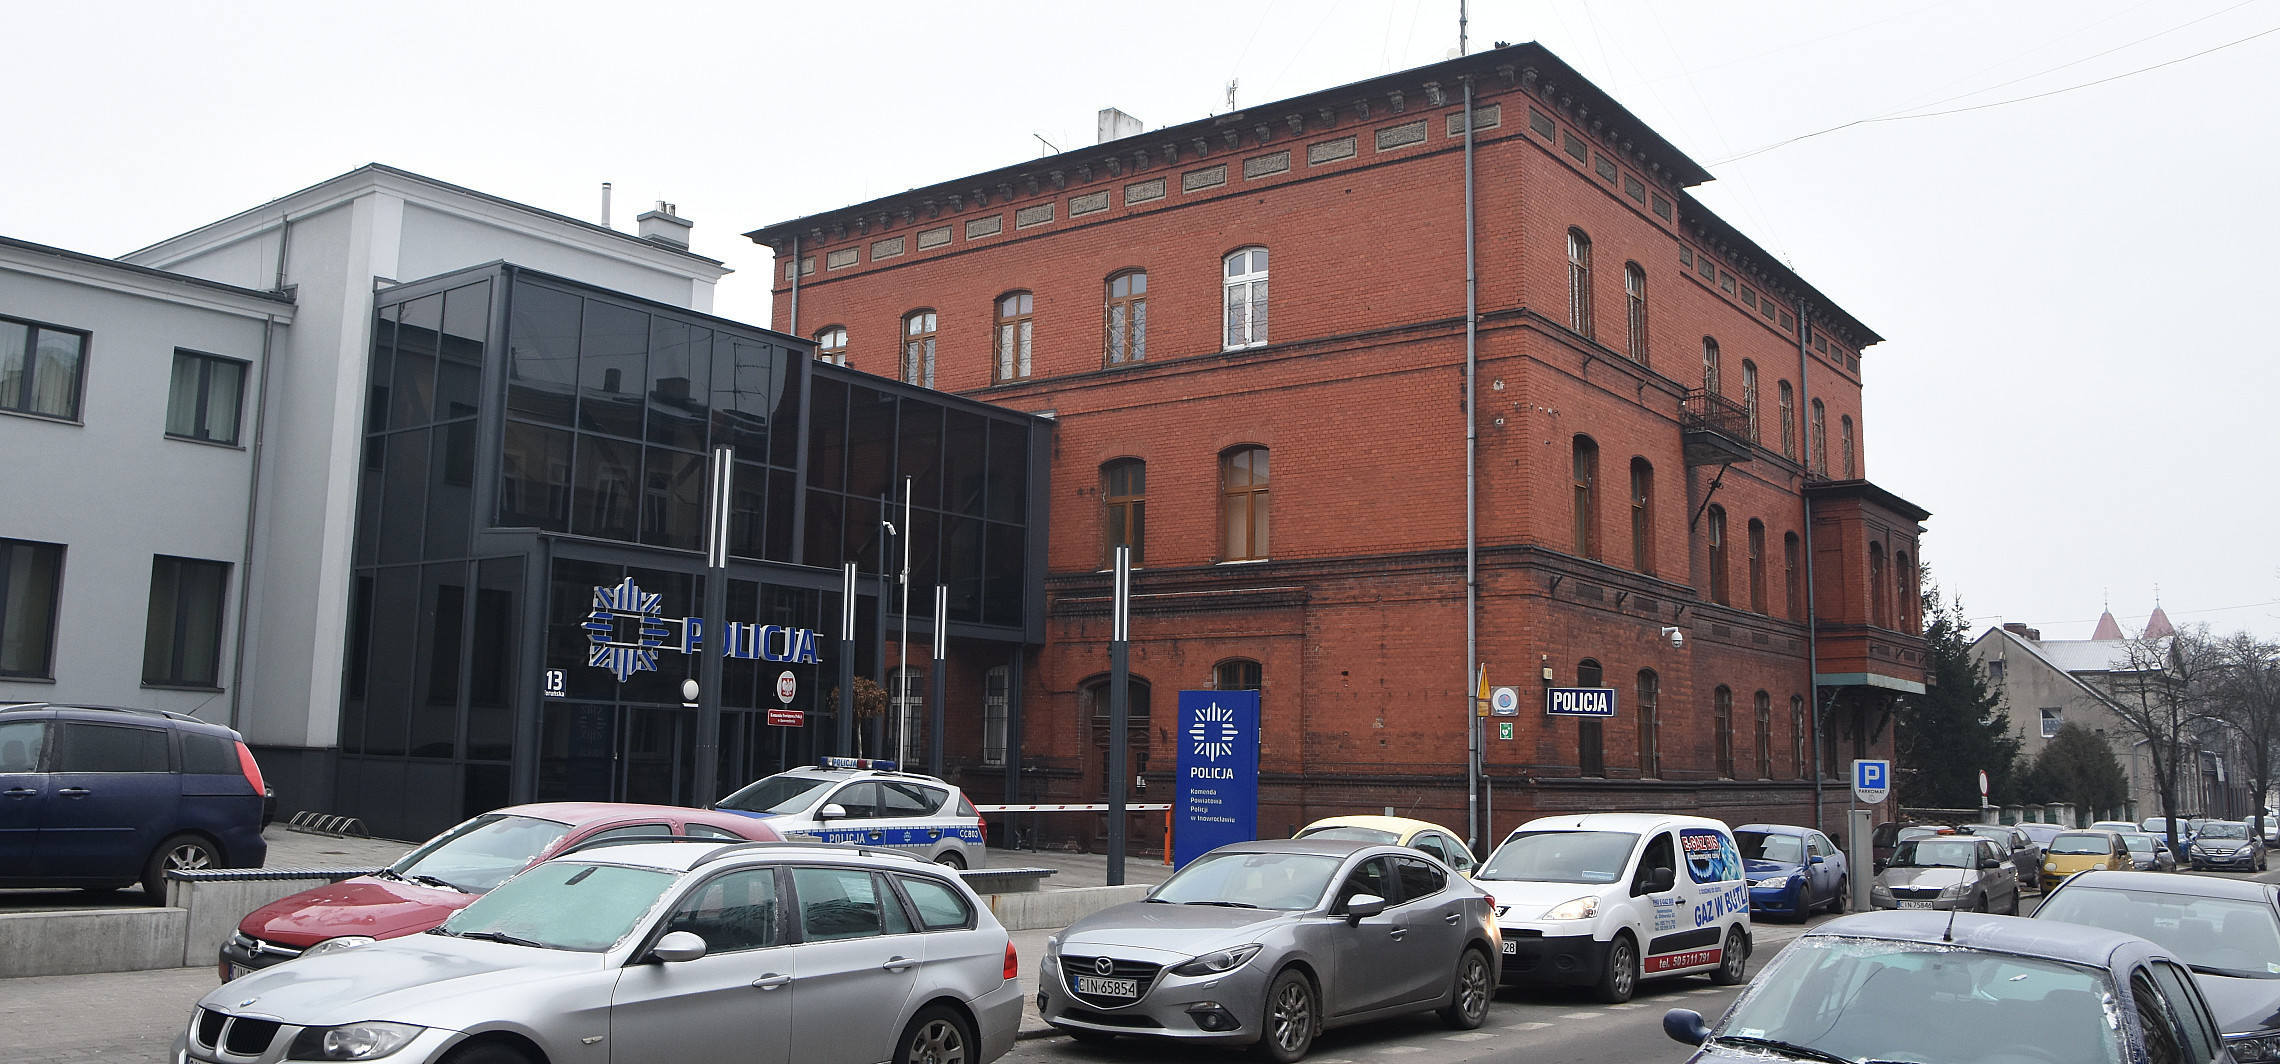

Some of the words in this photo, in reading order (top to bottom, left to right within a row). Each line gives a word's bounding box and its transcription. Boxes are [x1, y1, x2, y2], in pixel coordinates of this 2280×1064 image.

[546, 670, 563, 690] 13
[1553, 691, 1607, 712] POLICJA
[833, 758, 857, 768] POLICJA
[1190, 767, 1234, 780] POLICJA
[1864, 765, 1880, 786] P
[1190, 788, 1217, 796] Komenda
[1190, 797, 1223, 805] Powiatowa
[1190, 806, 1209, 814] Policji
[1681, 836, 1707, 851] E-GAZ
[1694, 900, 1715, 928] GAZ
[1714, 895, 1724, 918] W
[1502, 942, 1515, 953] 28
[1659, 957, 1670, 969] tel.
